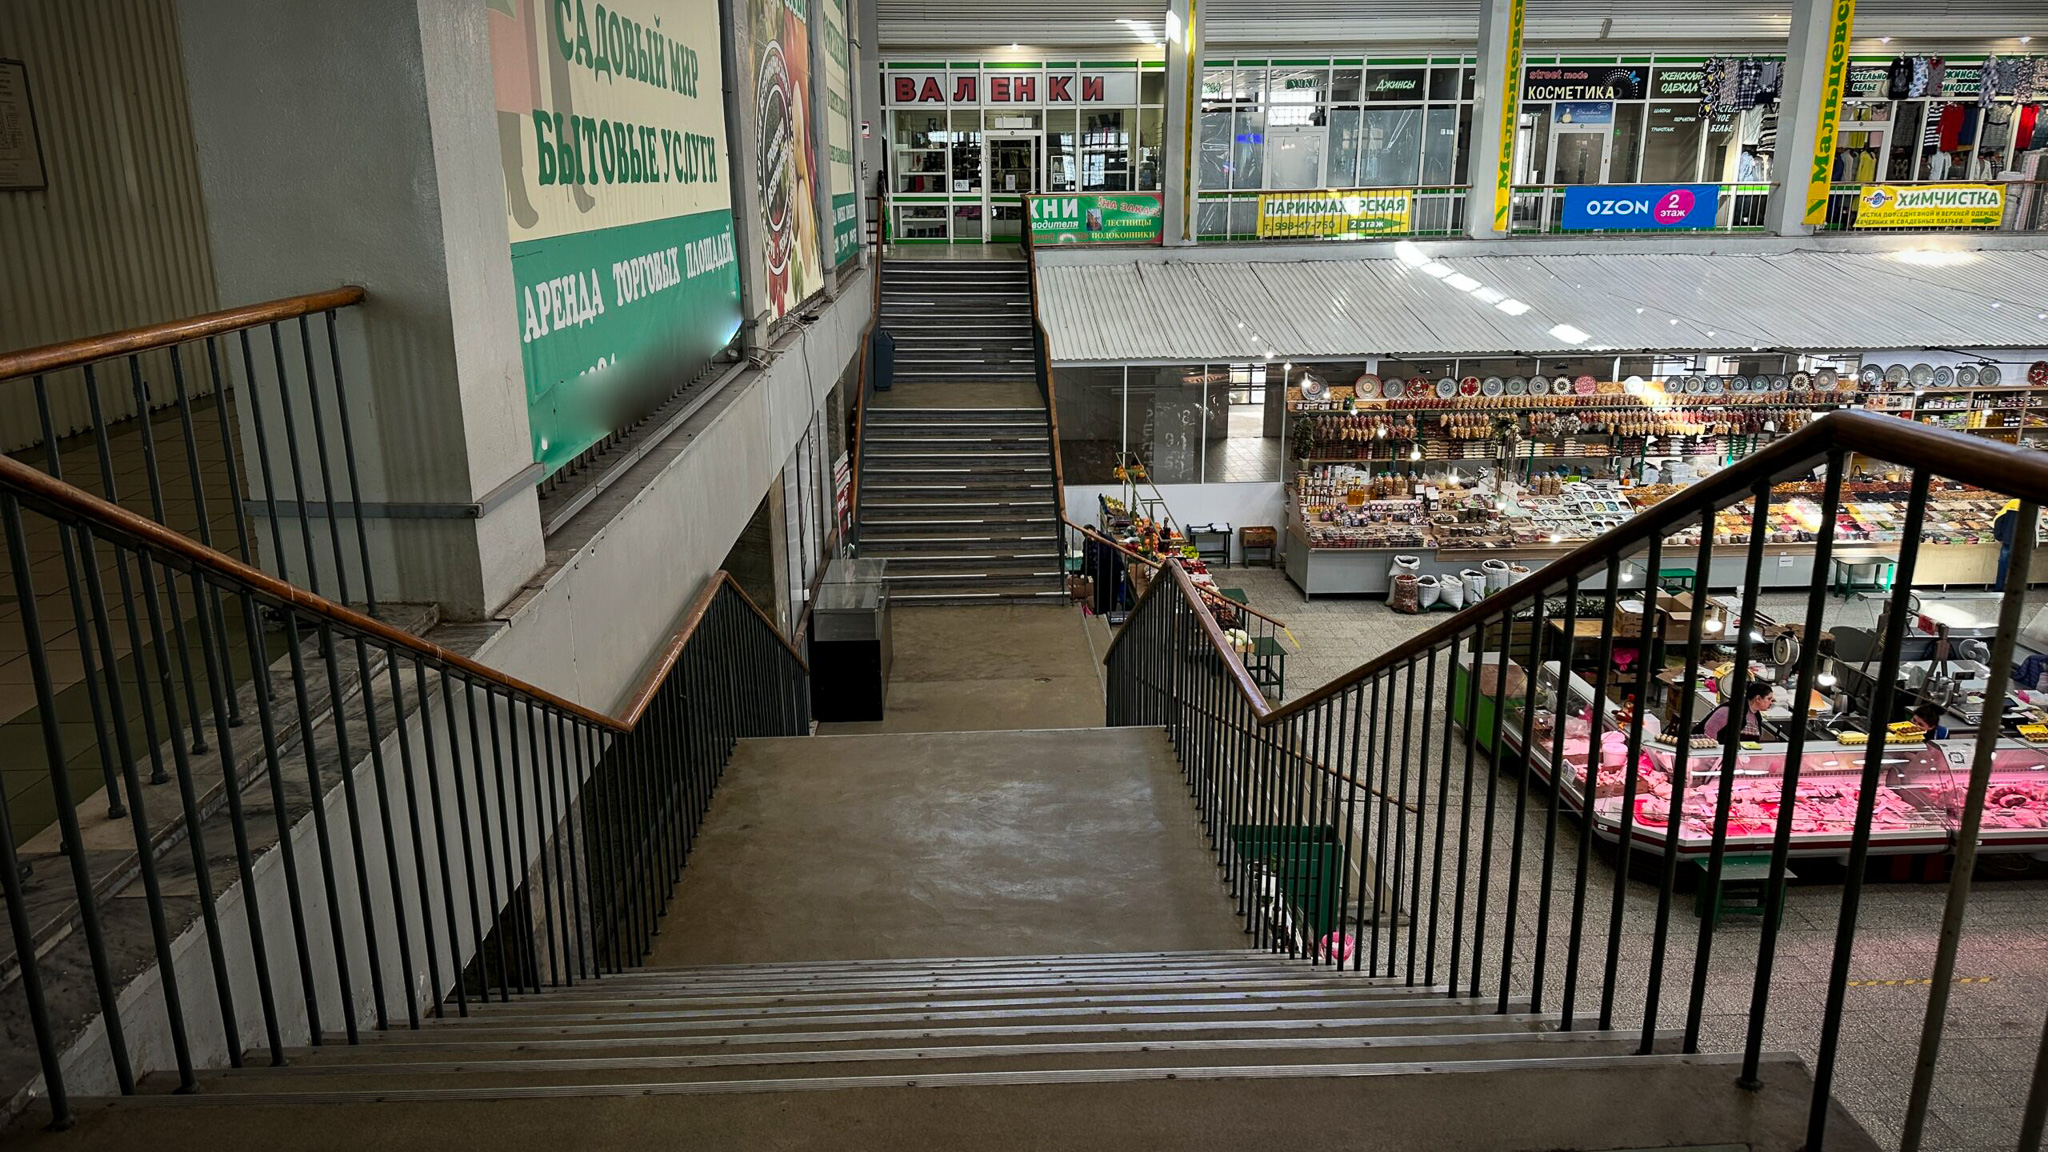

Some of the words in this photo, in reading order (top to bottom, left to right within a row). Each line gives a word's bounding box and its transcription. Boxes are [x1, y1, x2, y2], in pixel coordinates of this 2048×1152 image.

[554, 0, 668, 89] САДОВЫЙ
[668, 37, 699, 99] МИР
[1529, 69, 1562, 80] street
[1563, 71, 1589, 80] mode
[1660, 72, 1704, 80] ЖЕНСКАЯ
[1850, 72, 1887, 81] ОСТЕЛЬНО
[894, 76, 1104, 102] ВАЛЕНКИ
[1528, 86, 1615, 100] КОСМЕТИКА
[1661, 82, 1699, 94] ОДЕЖДА
[1811, 0, 1850, 184] Мальцевс
[1852, 83, 1878, 91] БЕЛЬЕ
[1942, 83, 1982, 92] ИКОТАЖ
[1710, 124, 1734, 133] БЕЛЬЕ
[532, 109, 661, 186] БЫТОВЫЕ
[661, 128, 718, 184] УСЛУГИ
[1668, 194, 1680, 209] 2
[1897, 191, 1999, 206] ХИМЧИСТКА
[1029, 198, 1079, 219] ХНИ
[1265, 199, 1406, 215] ПАРИКМАХРСКАЯ
[1586, 200, 1649, 215] OZON
[1660, 209, 1685, 217] этаж
[1032, 219, 1079, 230] водителя
[1104, 219, 1152, 227] ЛЕСТНИЦЫ
[1350, 219, 1357, 229] 2
[1360, 219, 1384, 228] этаж
[1091, 231, 1155, 240] ПОДОКОННИКИ
[523, 268, 605, 343] АРЕНДА
[612, 246, 681, 307] ТОРГОВЫХ
[684, 223, 735, 279] ПЛОЩАДЕЙ
